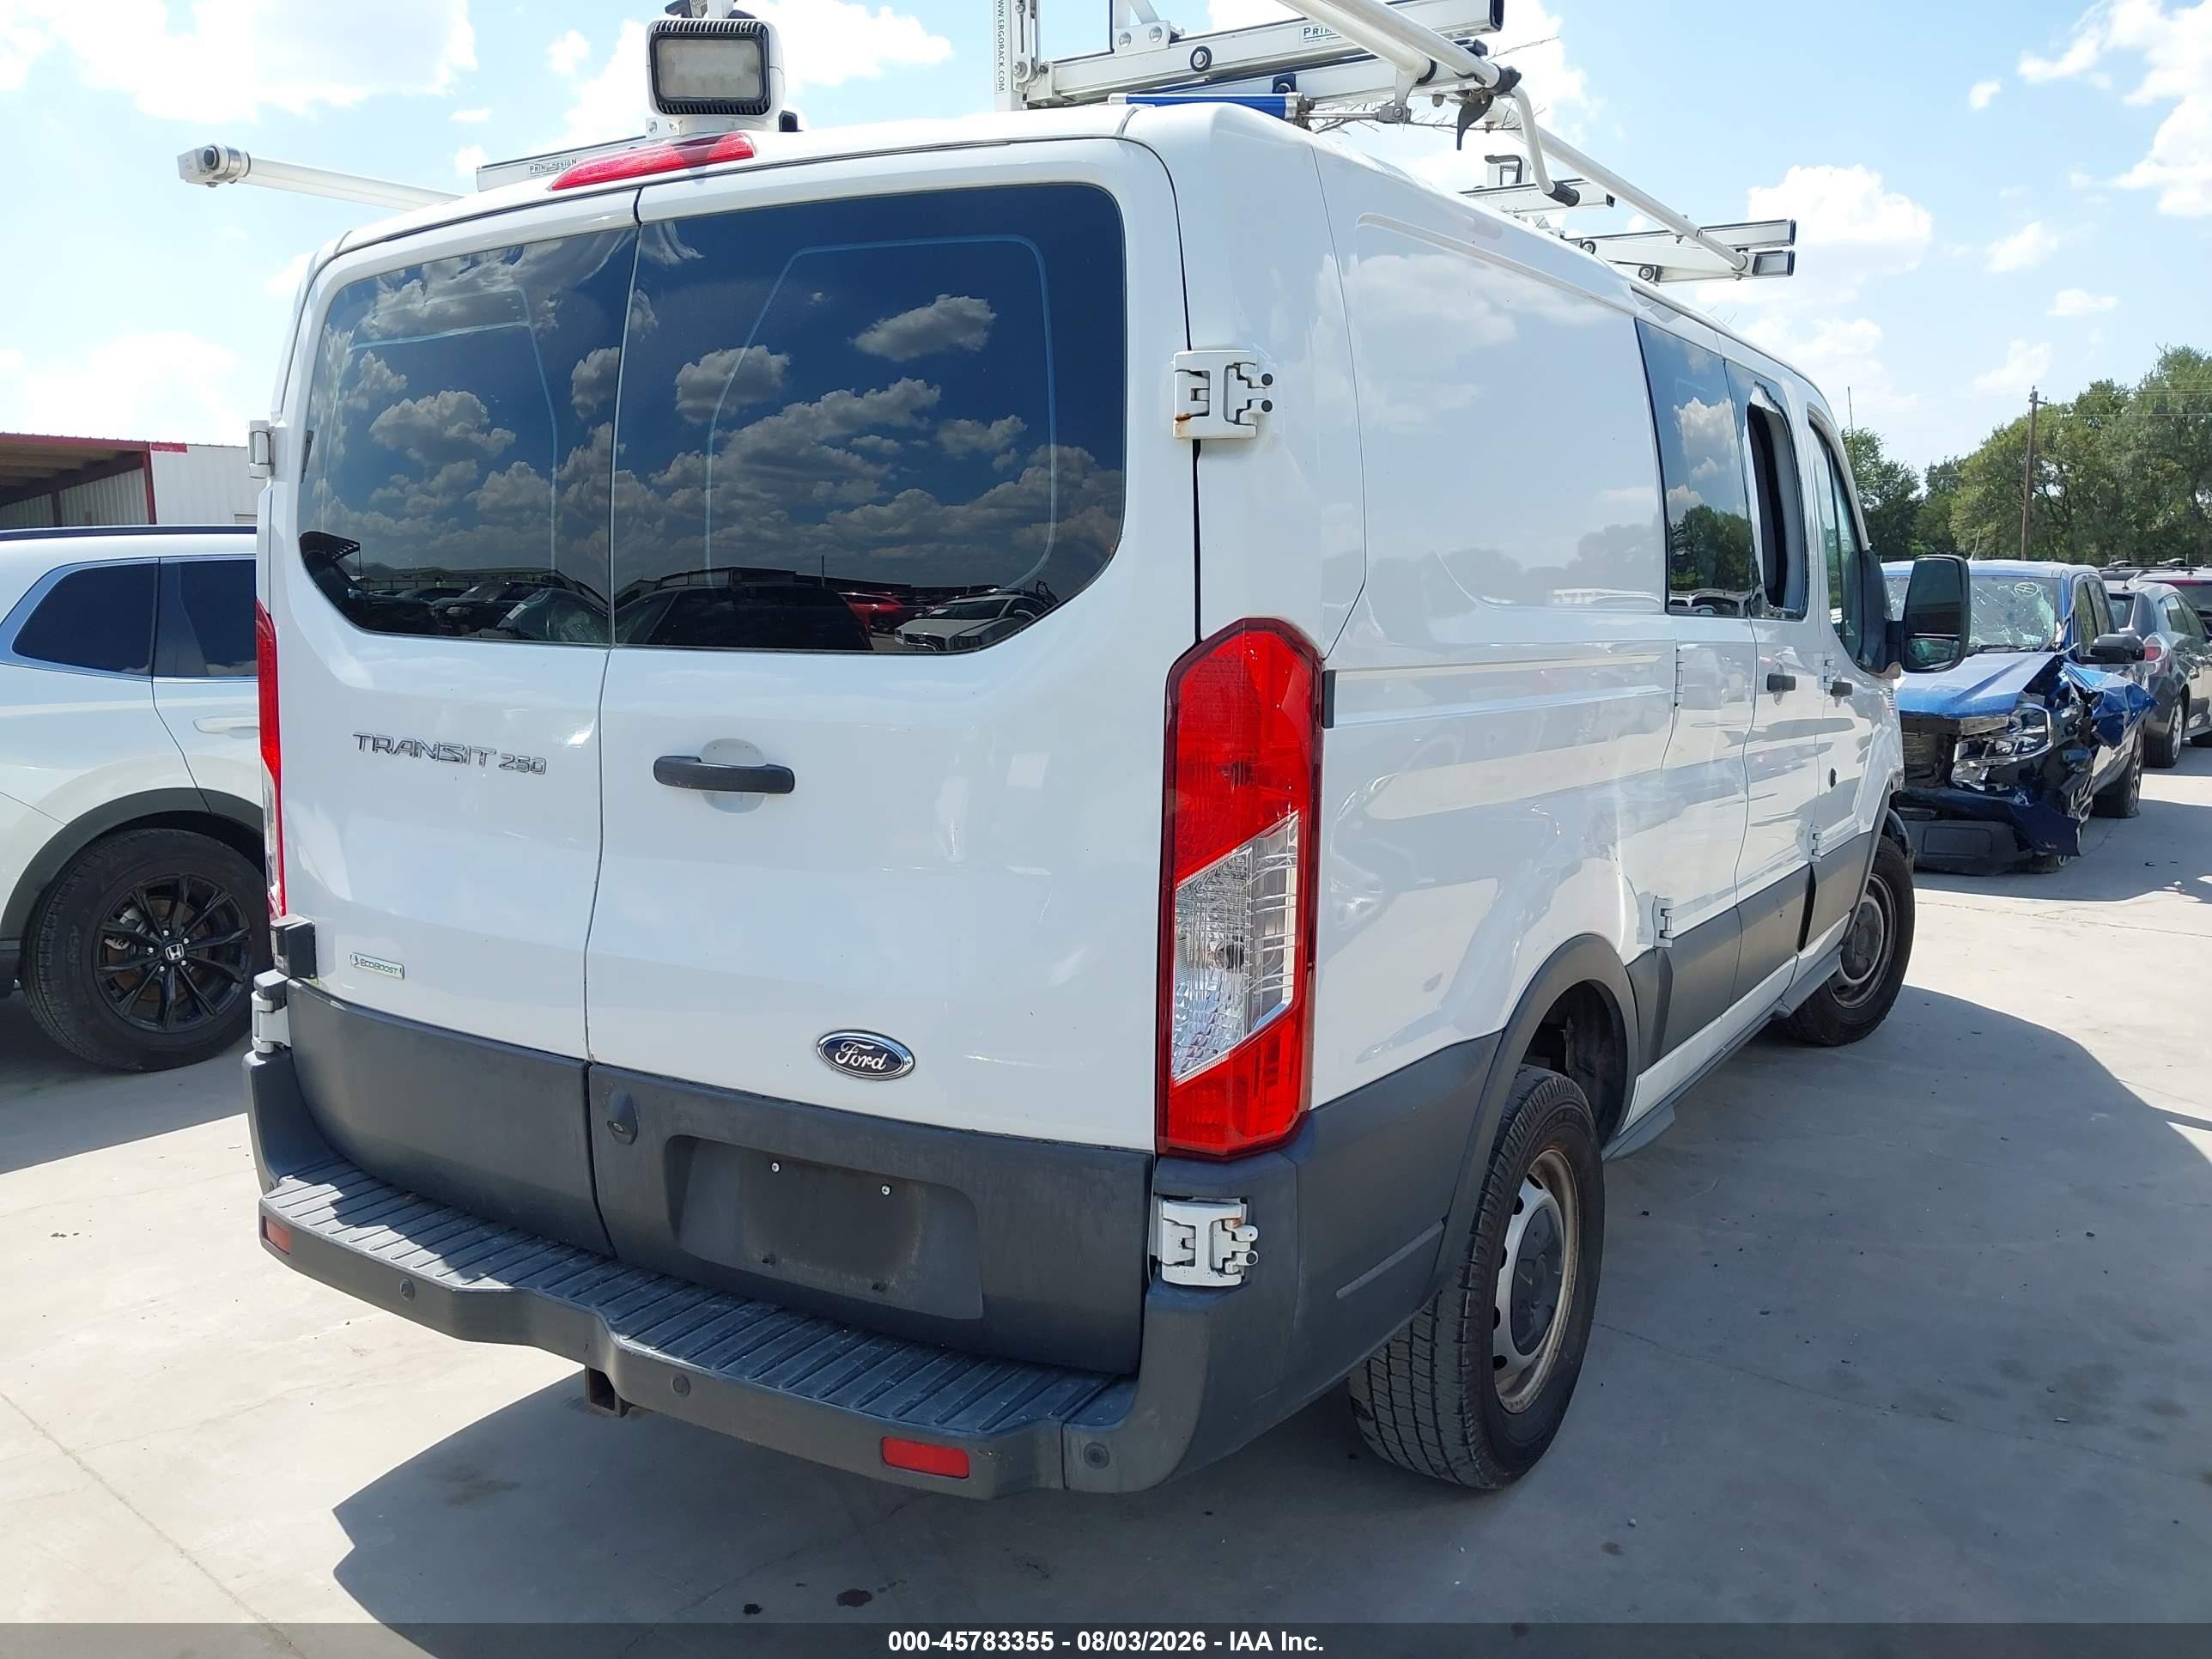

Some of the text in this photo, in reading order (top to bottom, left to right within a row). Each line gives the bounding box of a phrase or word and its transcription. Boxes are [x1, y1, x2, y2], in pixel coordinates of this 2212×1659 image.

[352, 732, 548, 775] TRANSIT 250
[835, 1041, 888, 1071] Ford
